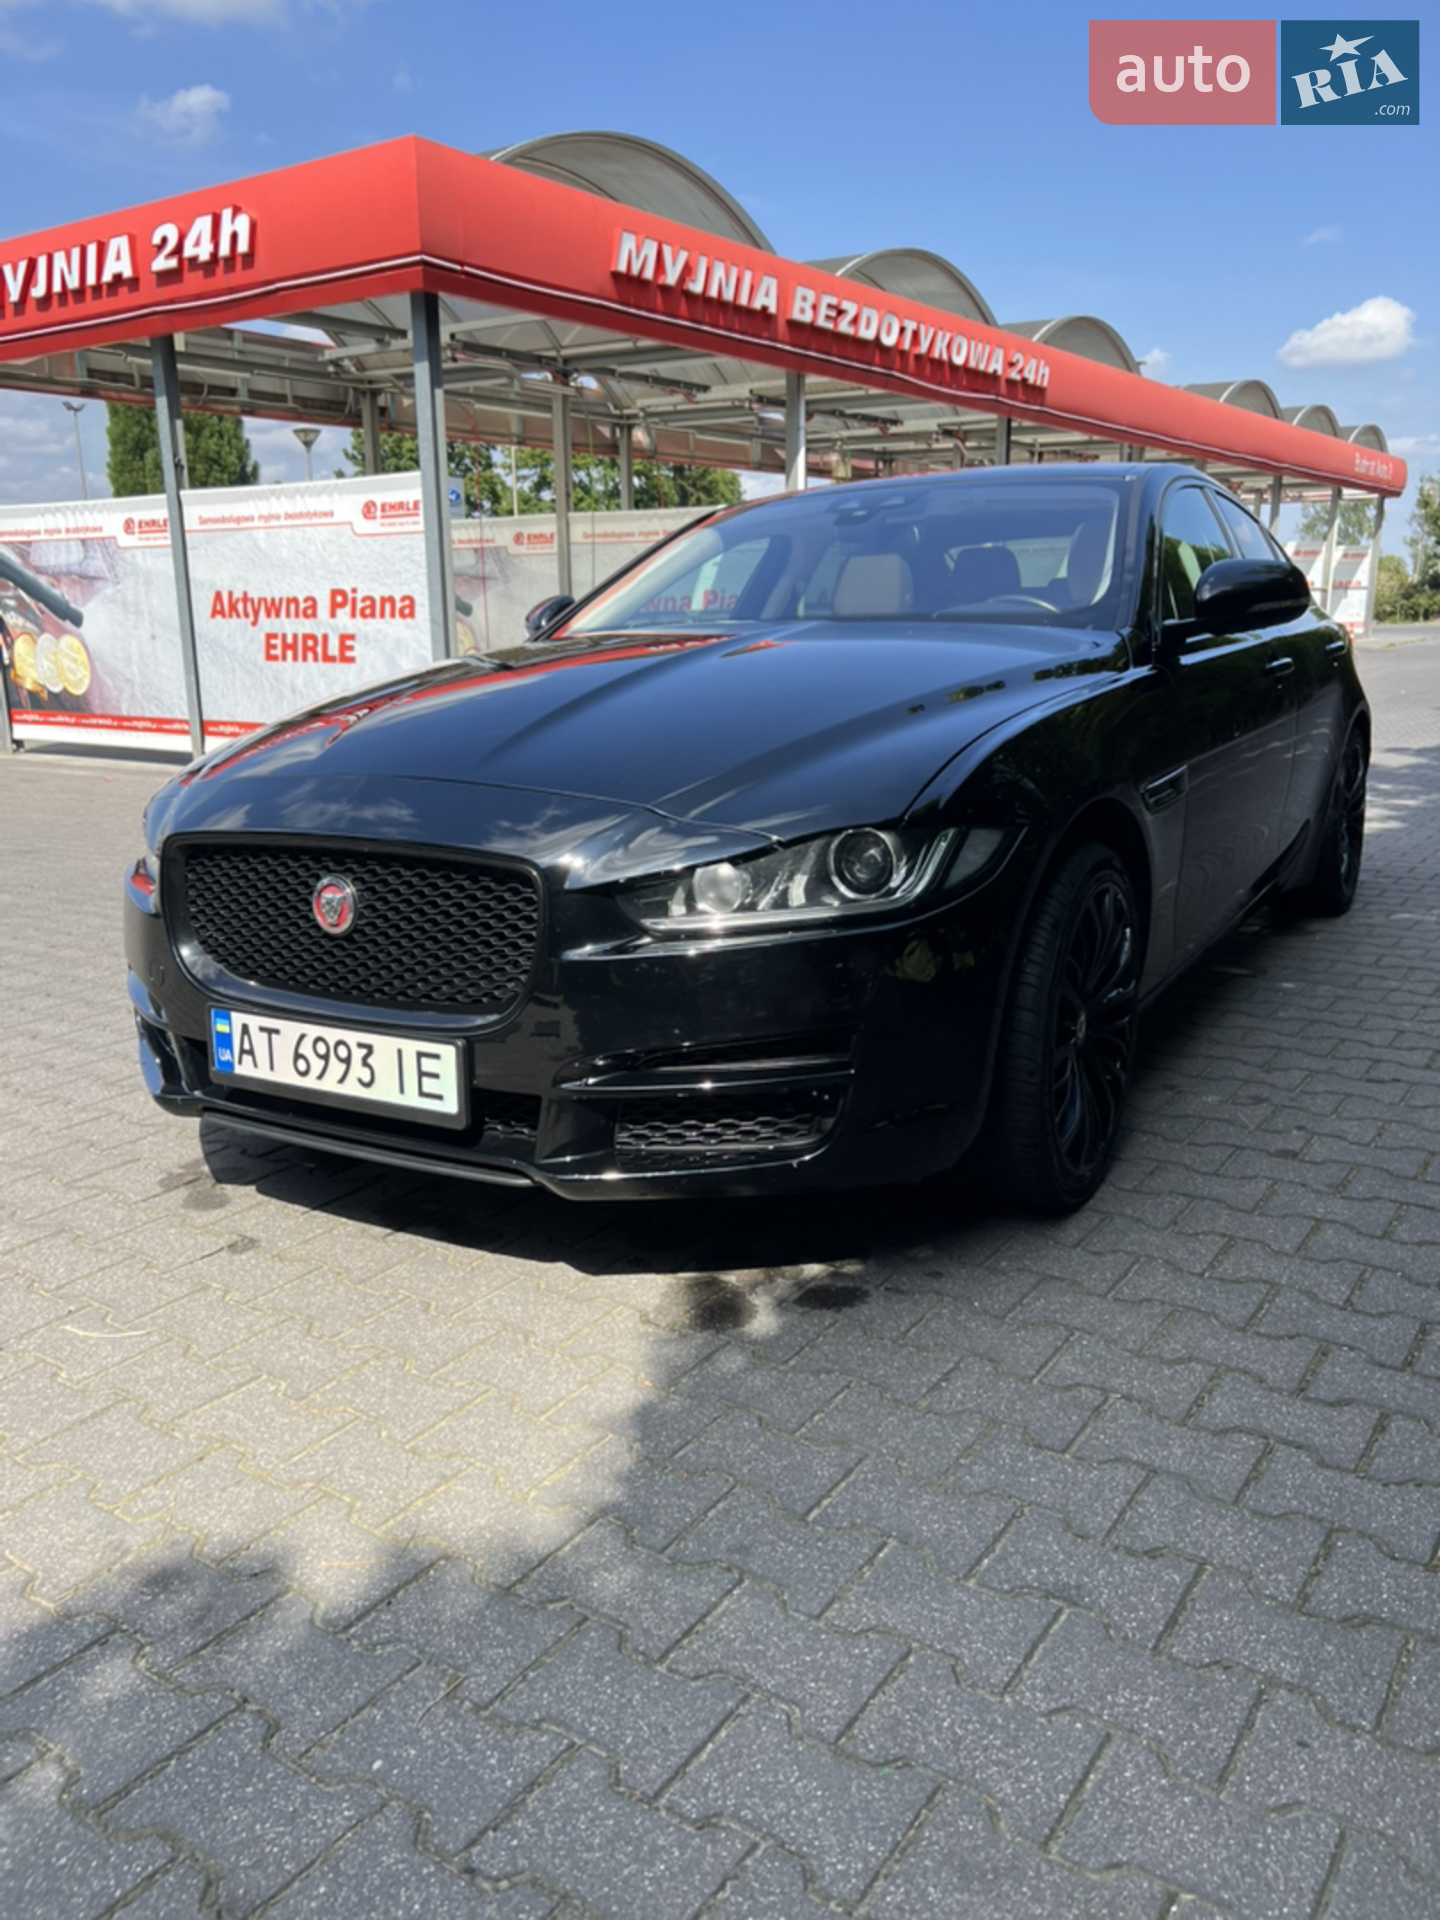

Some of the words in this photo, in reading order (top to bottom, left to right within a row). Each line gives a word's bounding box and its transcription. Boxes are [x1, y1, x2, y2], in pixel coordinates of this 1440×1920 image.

[0, 233, 134, 305] YJNIA
[150, 204, 253, 273] 24h
[616, 230, 778, 316] MYJNIA
[790, 284, 1005, 376] BEZDOTYKOWA
[1008, 352, 1051, 389] 24h
[138, 518, 169, 529] EHRLE
[379, 499, 421, 514] EHRLE
[209, 590, 319, 627] Aktywna
[328, 588, 416, 620] Piana
[263, 632, 356, 664] EHRLE
[217, 1047, 233, 1062] UA
[237, 1022, 281, 1072] AT
[292, 1033, 376, 1089] 6993
[397, 1047, 445, 1102] IE
